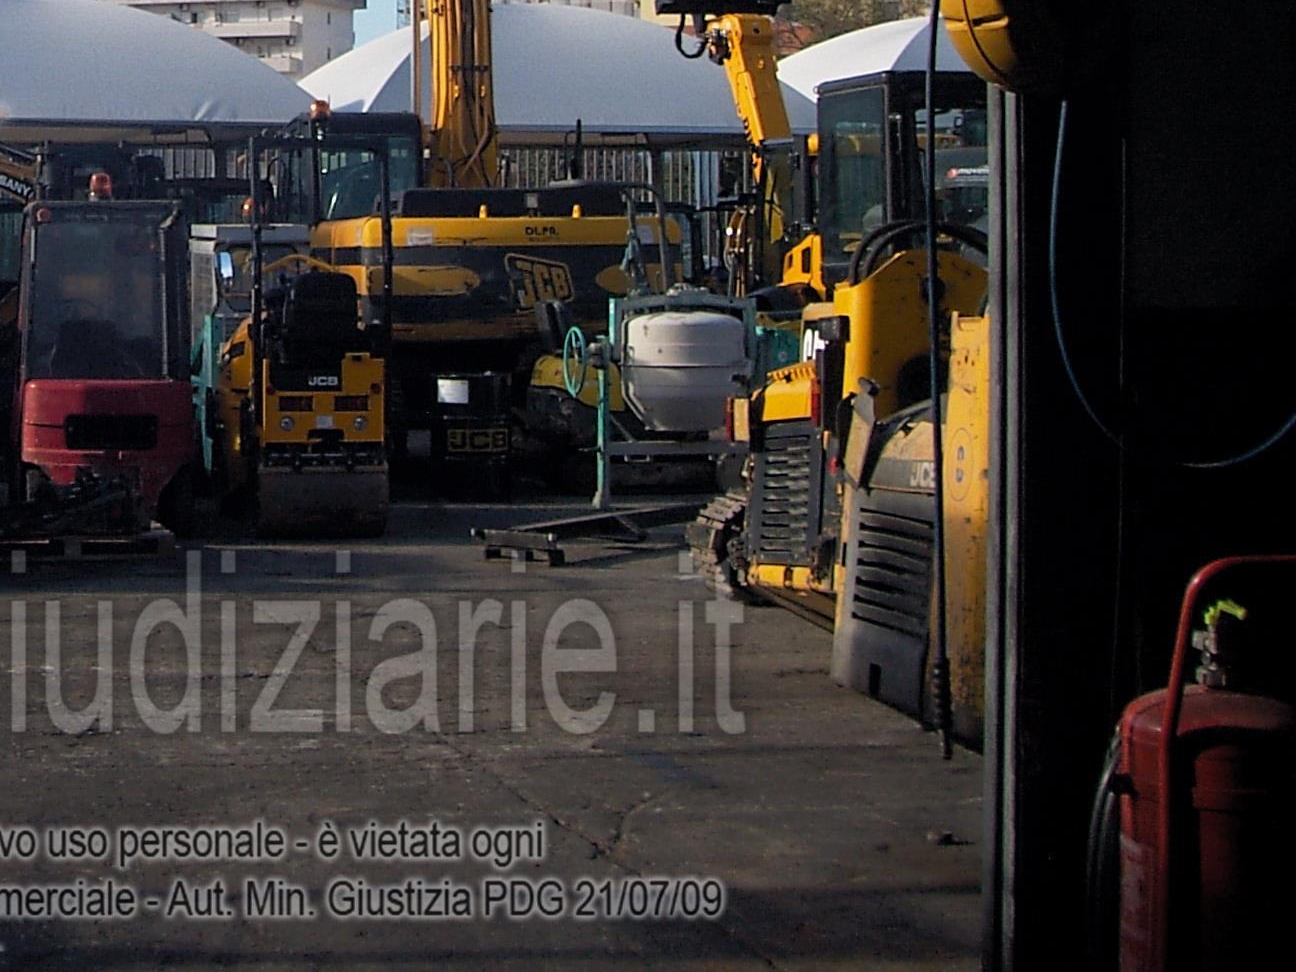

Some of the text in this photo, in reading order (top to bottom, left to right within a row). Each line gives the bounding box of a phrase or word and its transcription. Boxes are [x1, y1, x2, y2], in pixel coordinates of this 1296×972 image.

[515, 259, 571, 309] JCB
[307, 375, 339, 386] JCB
[449, 430, 507, 449] JCB
